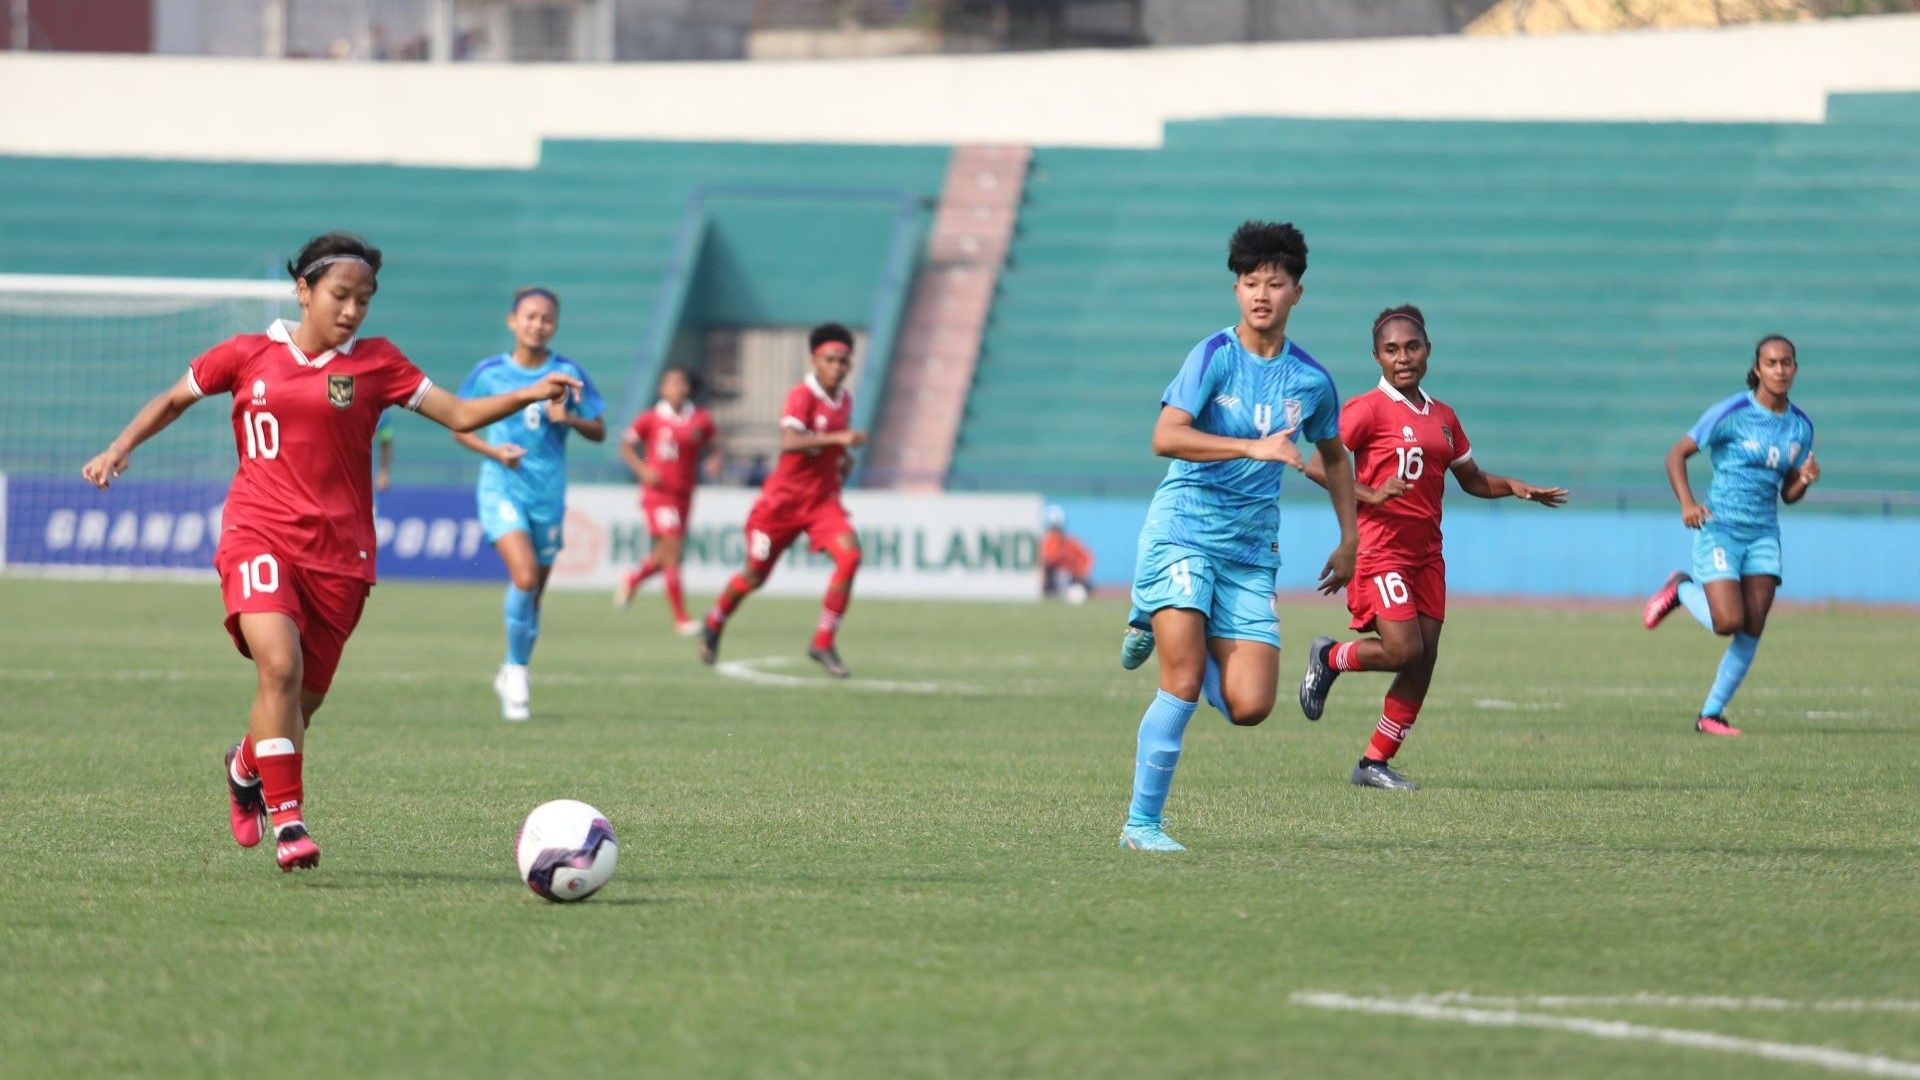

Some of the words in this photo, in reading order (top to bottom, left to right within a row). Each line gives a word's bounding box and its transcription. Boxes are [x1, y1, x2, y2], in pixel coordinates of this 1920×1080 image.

[524, 402, 541, 430] 6
[1253, 403, 1272, 438] 4
[243, 411, 279, 460] 10
[1396, 447, 1424, 480] 16
[45, 507, 205, 553] GRAND
[375, 517, 482, 560] PORT
[913, 526, 1037, 571] LAND
[239, 554, 279, 599] 10
[1170, 559, 1193, 596] 4
[1374, 572, 1409, 608] 16
